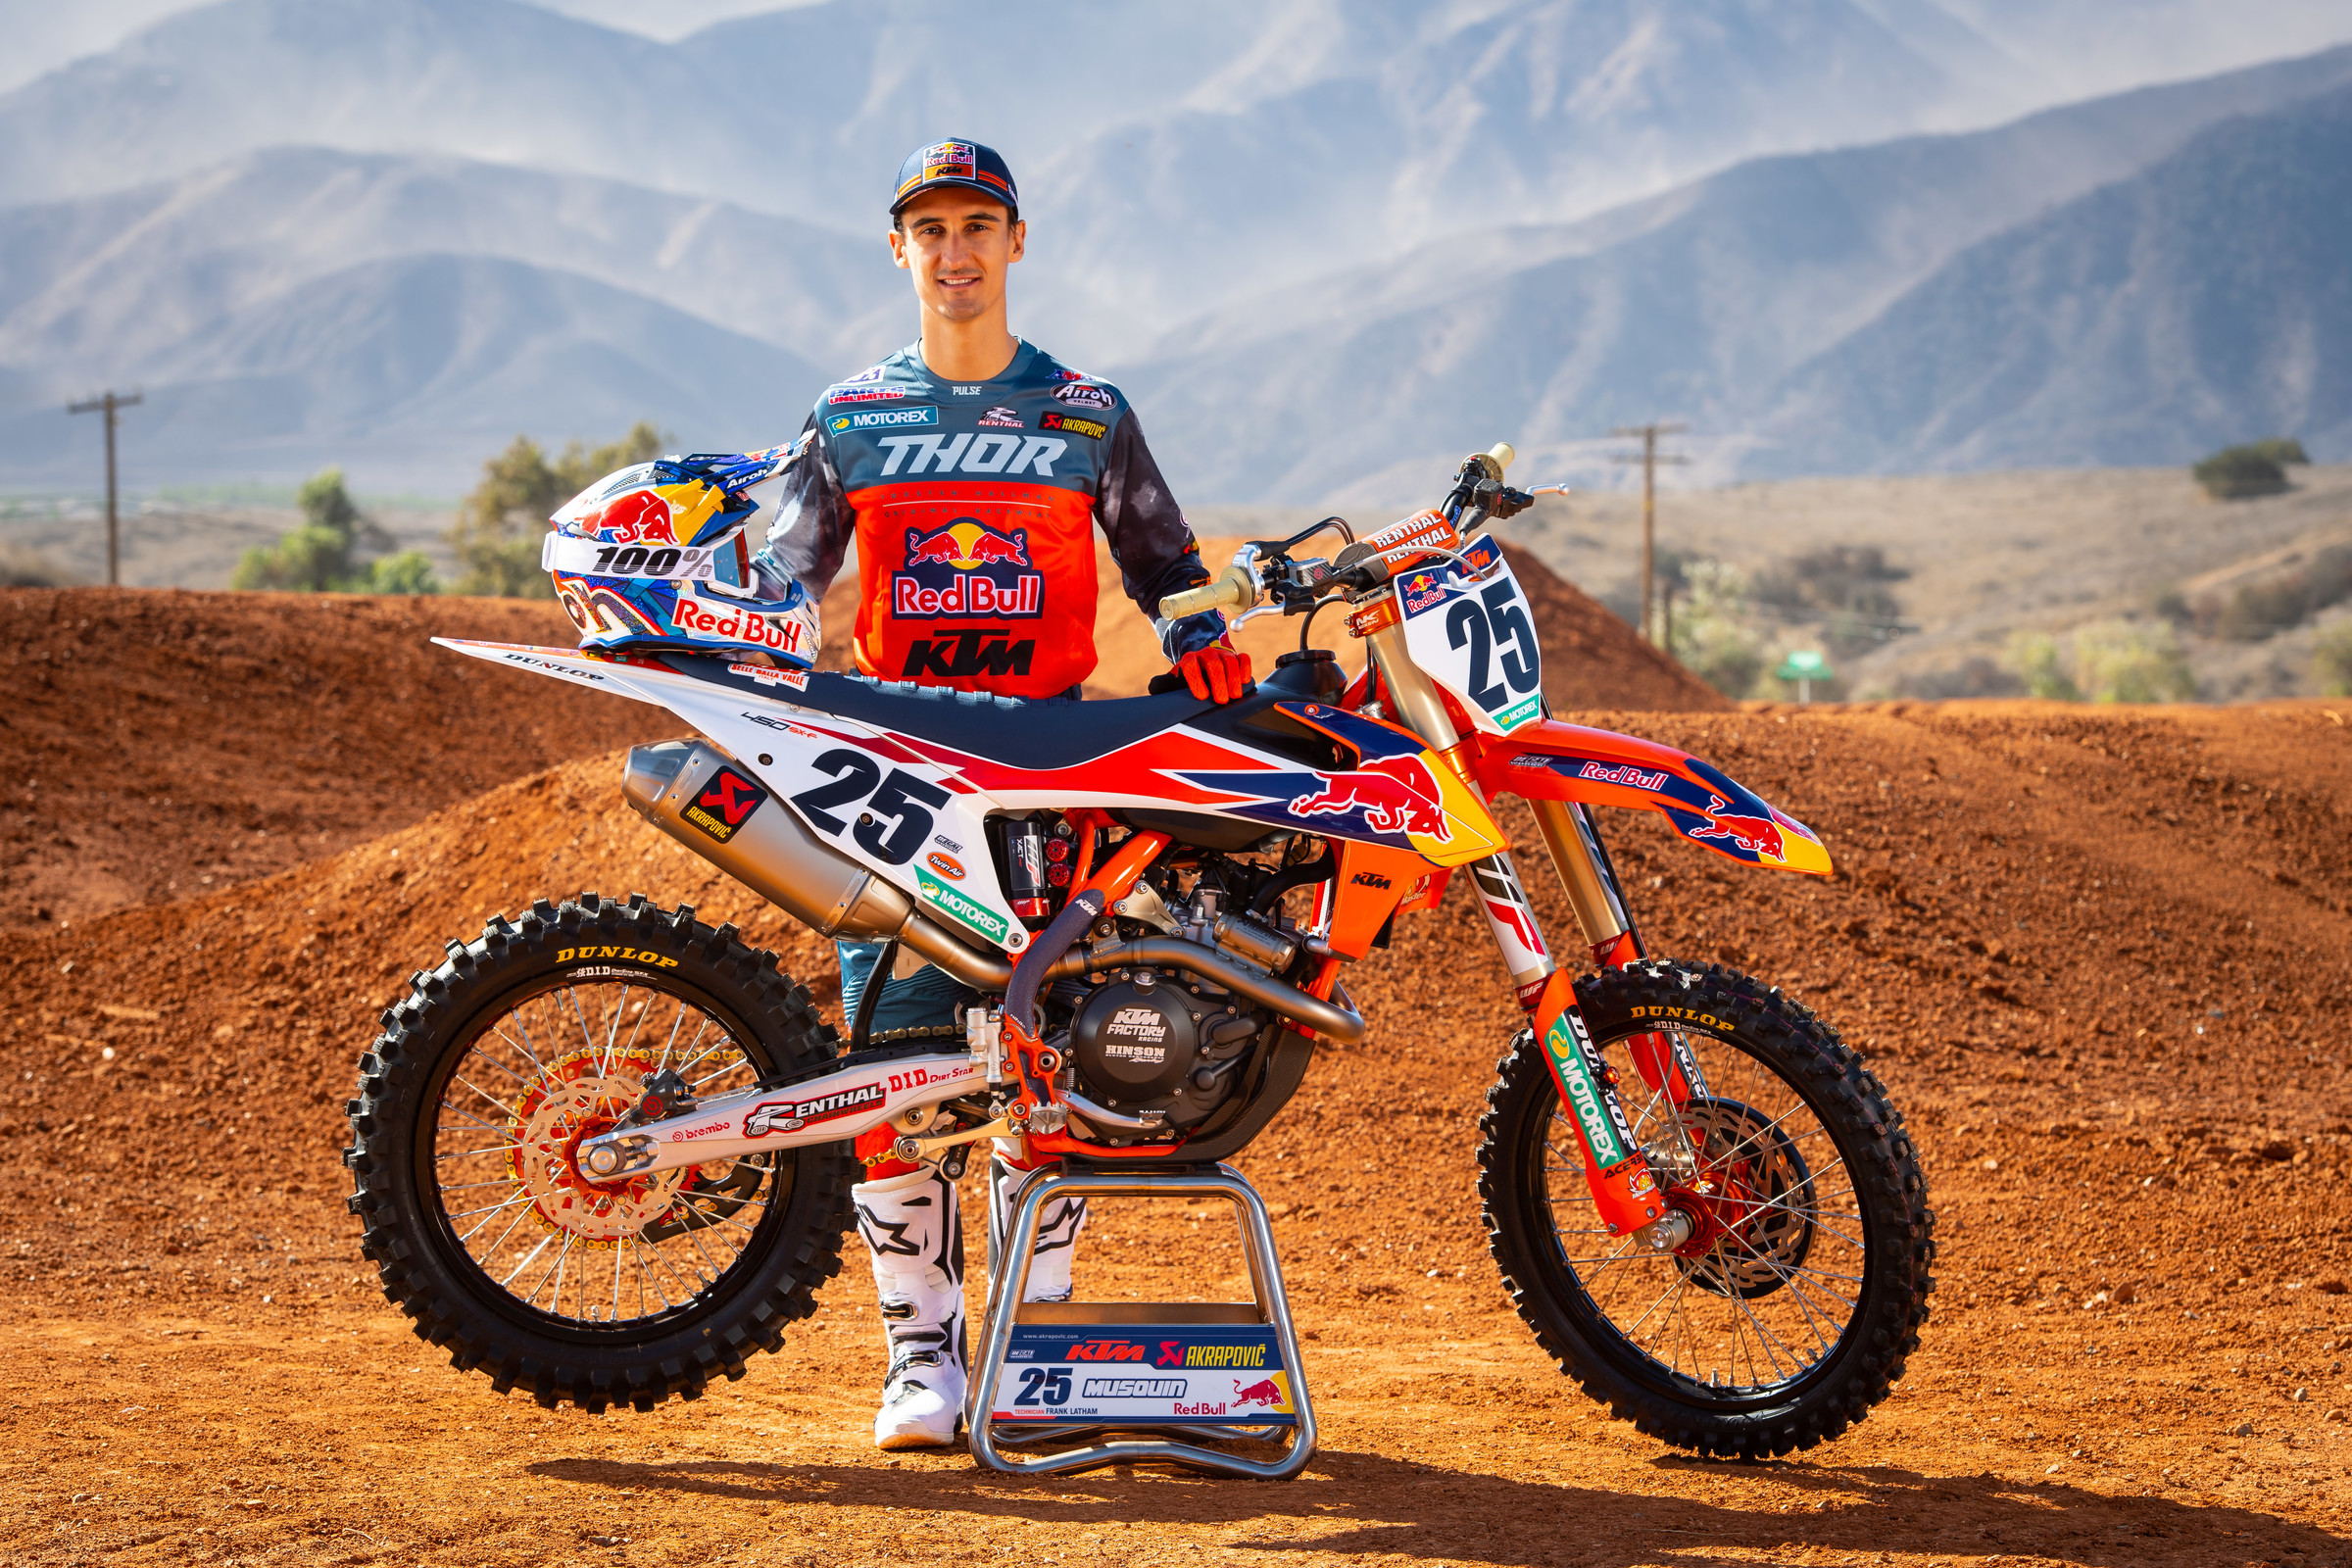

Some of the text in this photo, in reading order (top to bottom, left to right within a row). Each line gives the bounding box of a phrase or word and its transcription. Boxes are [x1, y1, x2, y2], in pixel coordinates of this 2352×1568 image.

[926, 154, 972, 167] Red Bull
[829, 392, 905, 404] UNLIMITED
[952, 385, 982, 395] PULSE
[1055, 385, 1112, 406] Airoh
[854, 410, 929, 426] MOTOREX
[977, 419, 1024, 428] RENTHAL
[877, 433, 1068, 477] THOR
[726, 468, 768, 489] Airoh
[1373, 513, 1442, 548] RENTHAL
[592, 546, 713, 577] 100%
[895, 574, 1041, 614] Red Bull
[1406, 586, 1447, 613] Red Bull
[673, 599, 802, 653] Red Bull
[902, 628, 1035, 676] KTM
[1446, 576, 1540, 713] 25
[503, 653, 605, 680] DUNLOP
[731, 663, 754, 674] SELLE
[782, 674, 806, 686] VALLE
[741, 711, 791, 731] 450
[1509, 700, 1538, 721] MOTOREX
[1580, 761, 1668, 791] Red Bull
[790, 749, 953, 865] 25
[929, 855, 965, 878] Twin Air
[1350, 872, 1392, 890] KTM
[939, 890, 1006, 937] MOTOREX
[1075, 899, 1098, 916] KTM
[556, 946, 679, 968] DUNLOP
[1113, 1008, 1160, 1025] KTM
[1631, 1005, 1735, 1031] DUNLOP
[1106, 1023, 1166, 1037] FACTORY
[1105, 1045, 1165, 1057] HINSON
[1569, 1013, 1637, 1151] DULOP
[747, 1086, 884, 1137] RENTHAL
[807, 1100, 883, 1124] CHAINWHEELS
[1560, 1058, 1617, 1164] MOTOREX
[686, 1122, 730, 1140] brembo
[1064, 1340, 1146, 1361] KTM
[1013, 1367, 1074, 1405] 25
[1173, 1402, 1226, 1415] Red Bull
